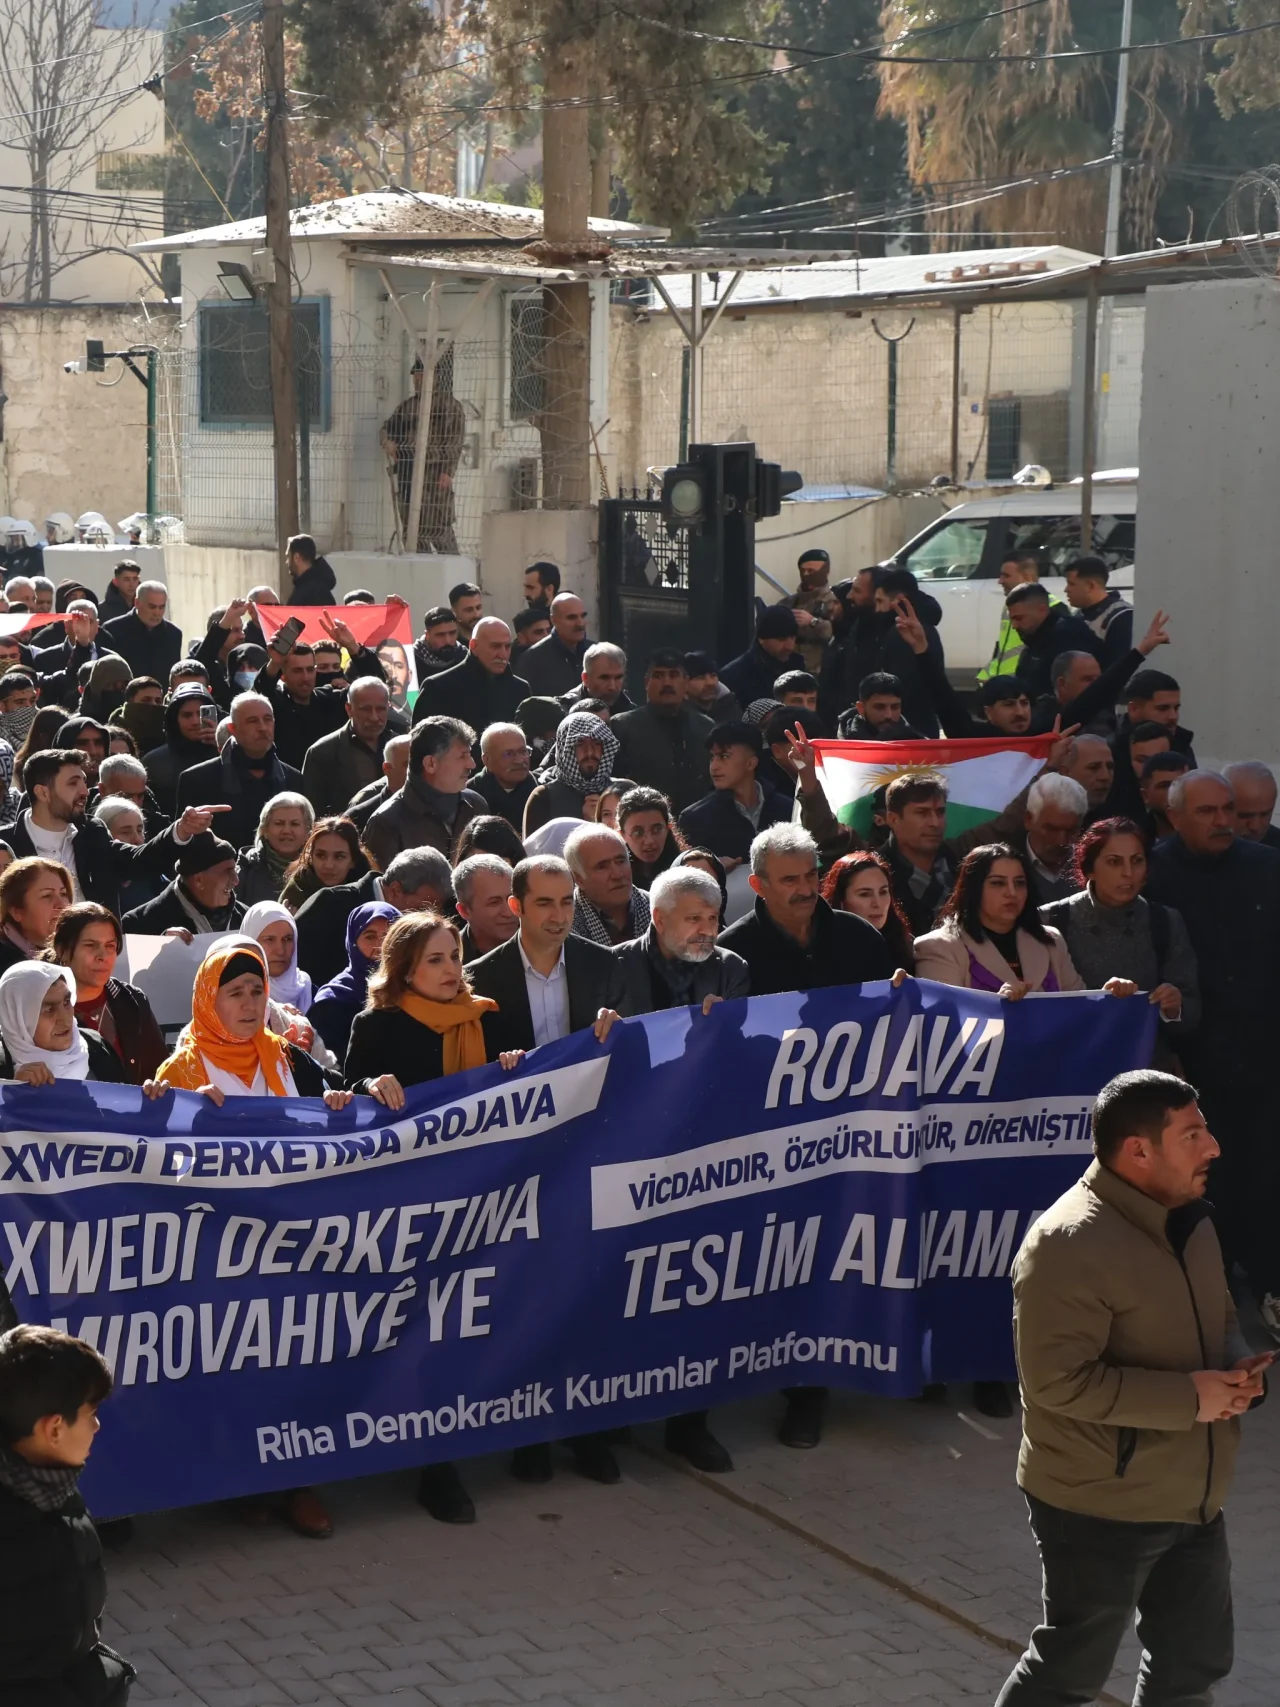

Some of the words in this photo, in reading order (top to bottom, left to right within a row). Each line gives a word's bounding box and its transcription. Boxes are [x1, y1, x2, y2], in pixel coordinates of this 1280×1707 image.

[764, 1014, 1005, 1109] ROJAVA
[0, 1137, 148, 1183] XWEDÎ
[159, 1128, 401, 1178] DERKETINA
[413, 1083, 556, 1150] ROJAVA
[628, 1151, 775, 1211] VİCDANDIR,
[3, 1202, 216, 1296] XWEDÎ
[216, 1174, 541, 1278] DERKETINA
[624, 1212, 822, 1319] TESLİM
[829, 1209, 1044, 1289] ALNAM
[427, 1266, 496, 1342] YE
[256, 1421, 336, 1463] Riha
[346, 1382, 554, 1449] Demokratik
[566, 1356, 718, 1410] Kurumlar
[728, 1331, 898, 1379] Platformu
